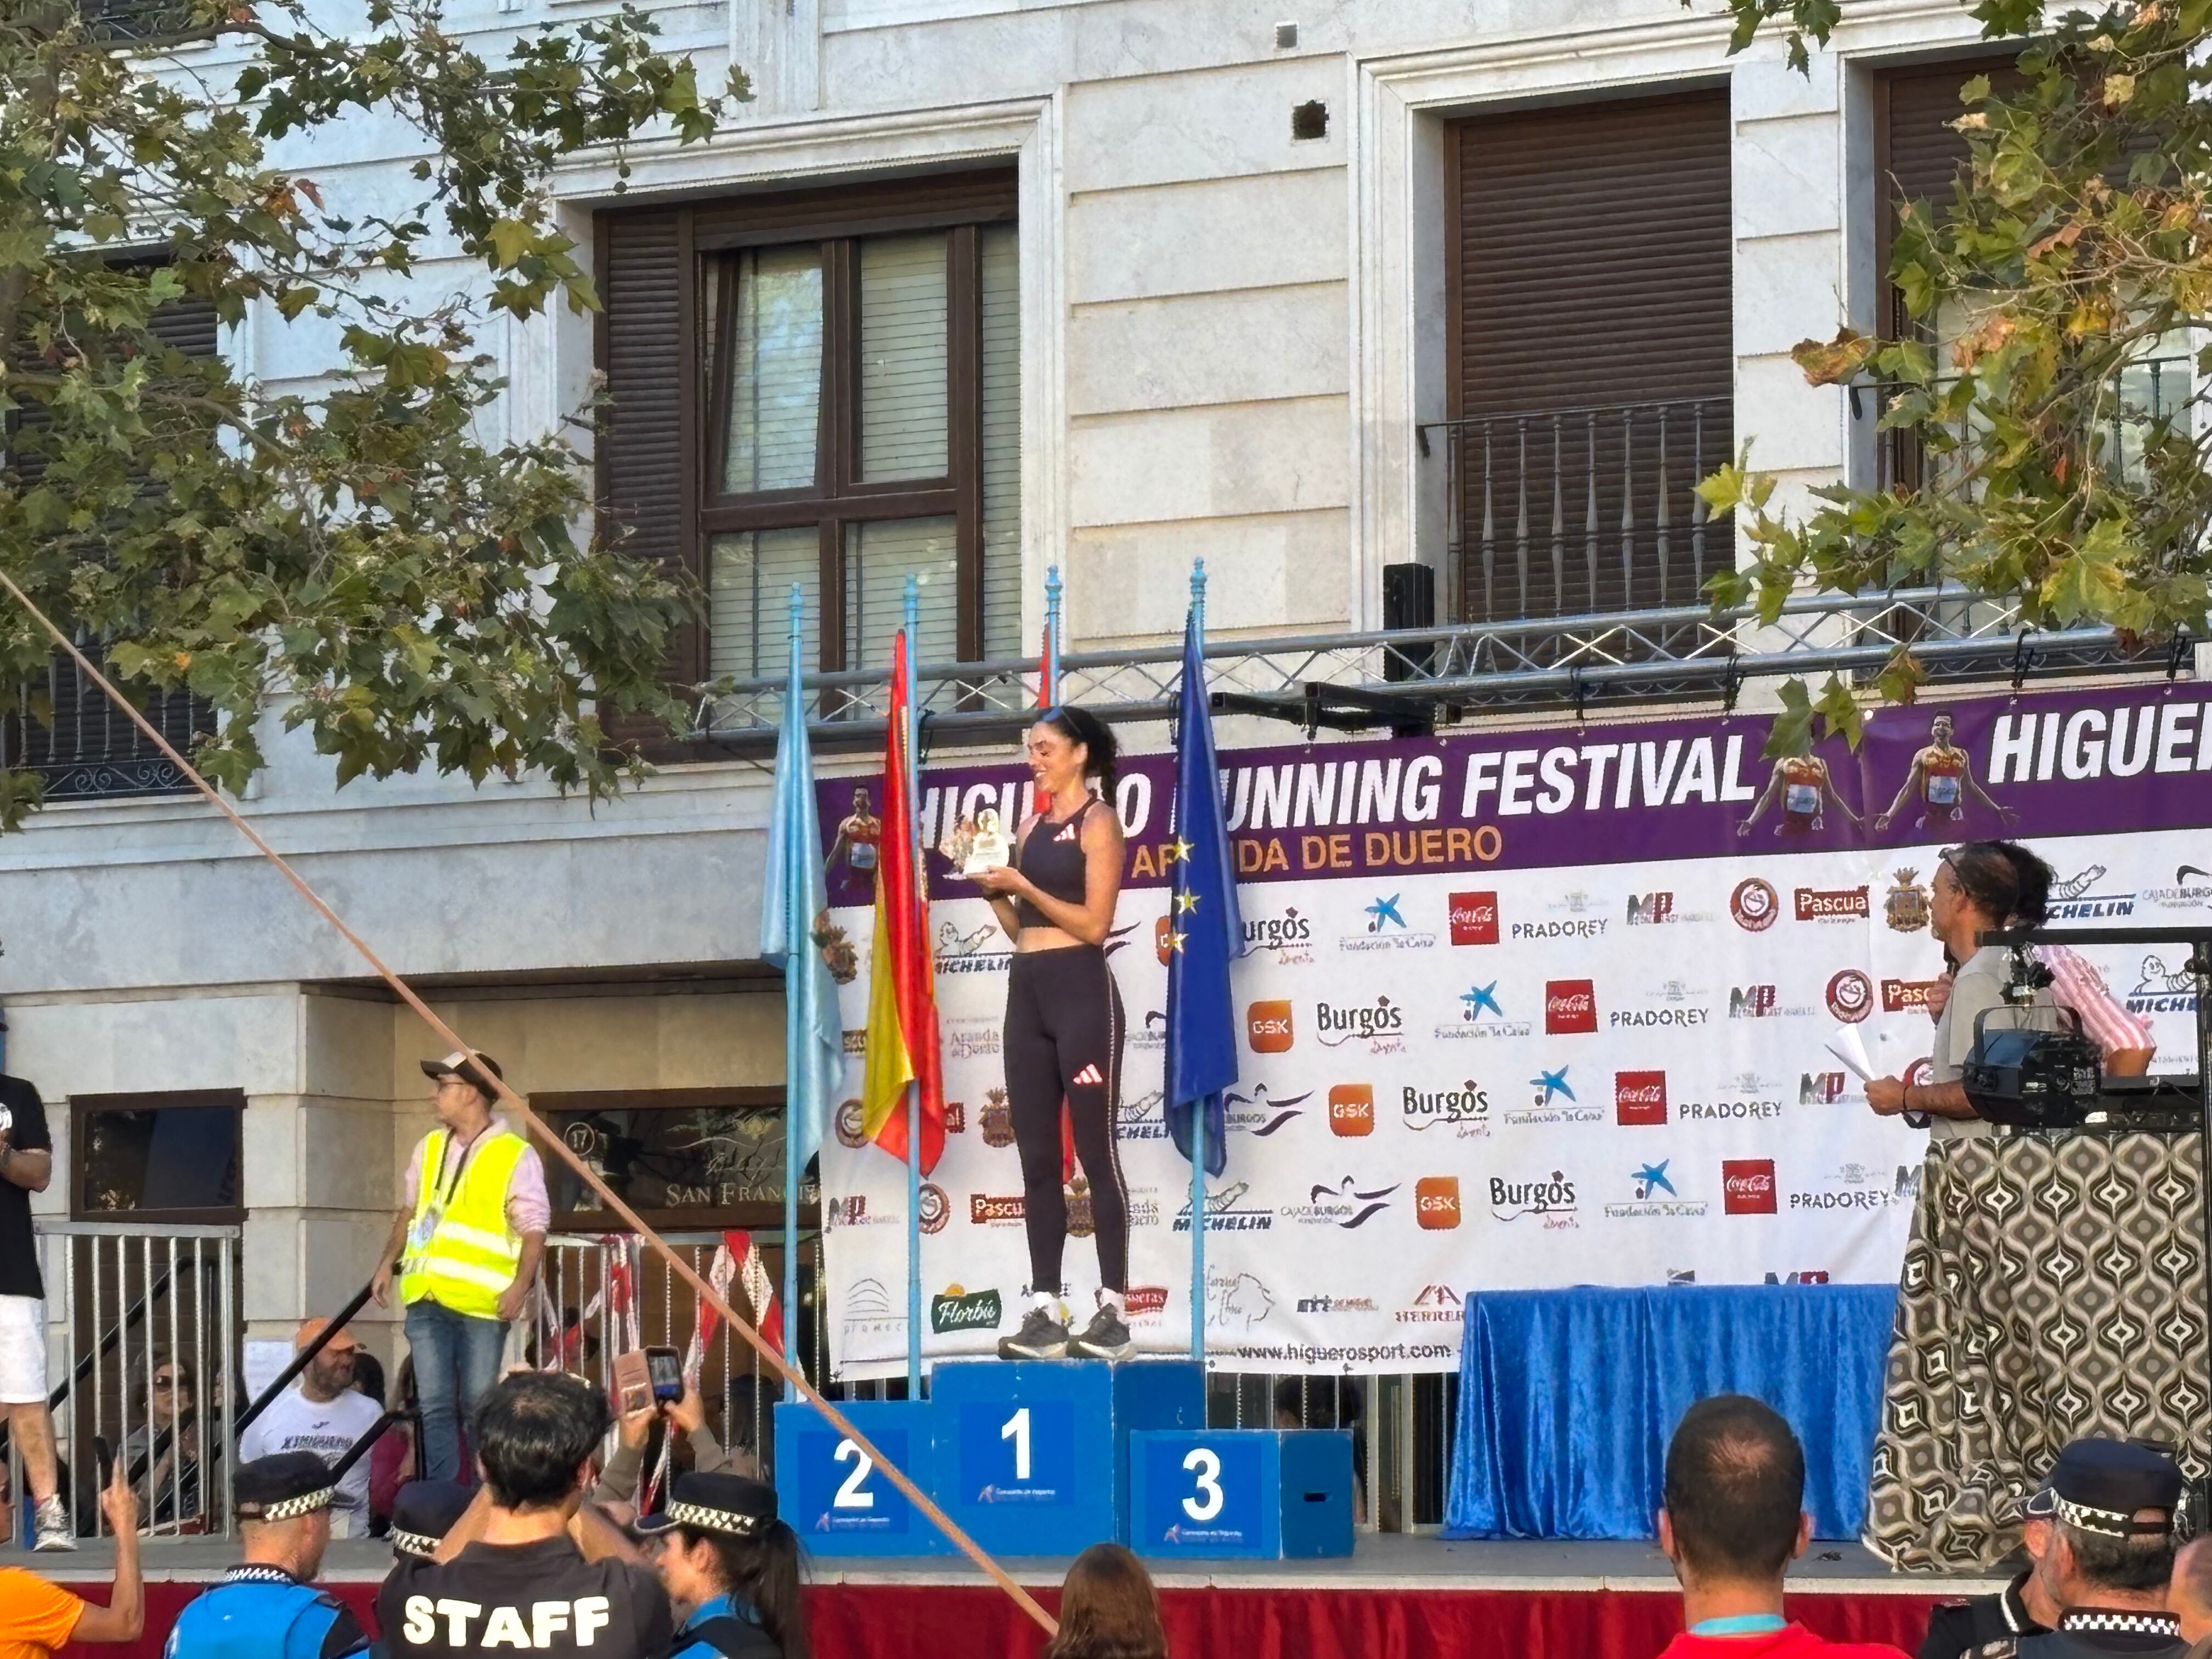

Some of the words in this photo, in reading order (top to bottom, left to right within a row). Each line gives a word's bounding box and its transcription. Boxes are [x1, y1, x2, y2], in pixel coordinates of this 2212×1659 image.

[1988, 703, 2212, 784] HIGUE
[1169, 755, 1443, 835] UNNING
[1462, 735, 1756, 819] FESTIVAL
[1301, 834, 1353, 869] DE
[1366, 825, 1503, 867] DUERO
[1800, 893, 1866, 912] Pascua
[2046, 901, 2134, 919] CHELIN
[1242, 918, 1310, 950] urgos
[1511, 918, 1608, 939] PRADOREY
[1888, 985, 1930, 1003] Pasc
[2126, 996, 2197, 1013] MICHE
[1253, 1018, 1289, 1034] GSK
[1318, 1002, 1403, 1039] Burgos
[1610, 1008, 1709, 1028] PRADOREY
[1333, 1103, 1369, 1119] GSK
[1403, 1086, 1487, 1123] Burgos
[1680, 1101, 1782, 1120] PRADOREY
[665, 1183, 712, 1207] SAN
[1420, 1197, 1455, 1211] GSK
[1490, 1177, 1575, 1214] Burgos
[1790, 1190, 1889, 1210] PRADOREY
[1172, 1216, 1272, 1231] MCHELIN
[1395, 1310, 1465, 1323] HERRER
[1237, 1342, 1453, 1364] www.higuerosport.com
[1001, 1408, 1030, 1480] 1
[833, 1438, 874, 1508] 2
[1182, 1448, 1224, 1521] 3
[403, 1595, 610, 1648] STAFF
